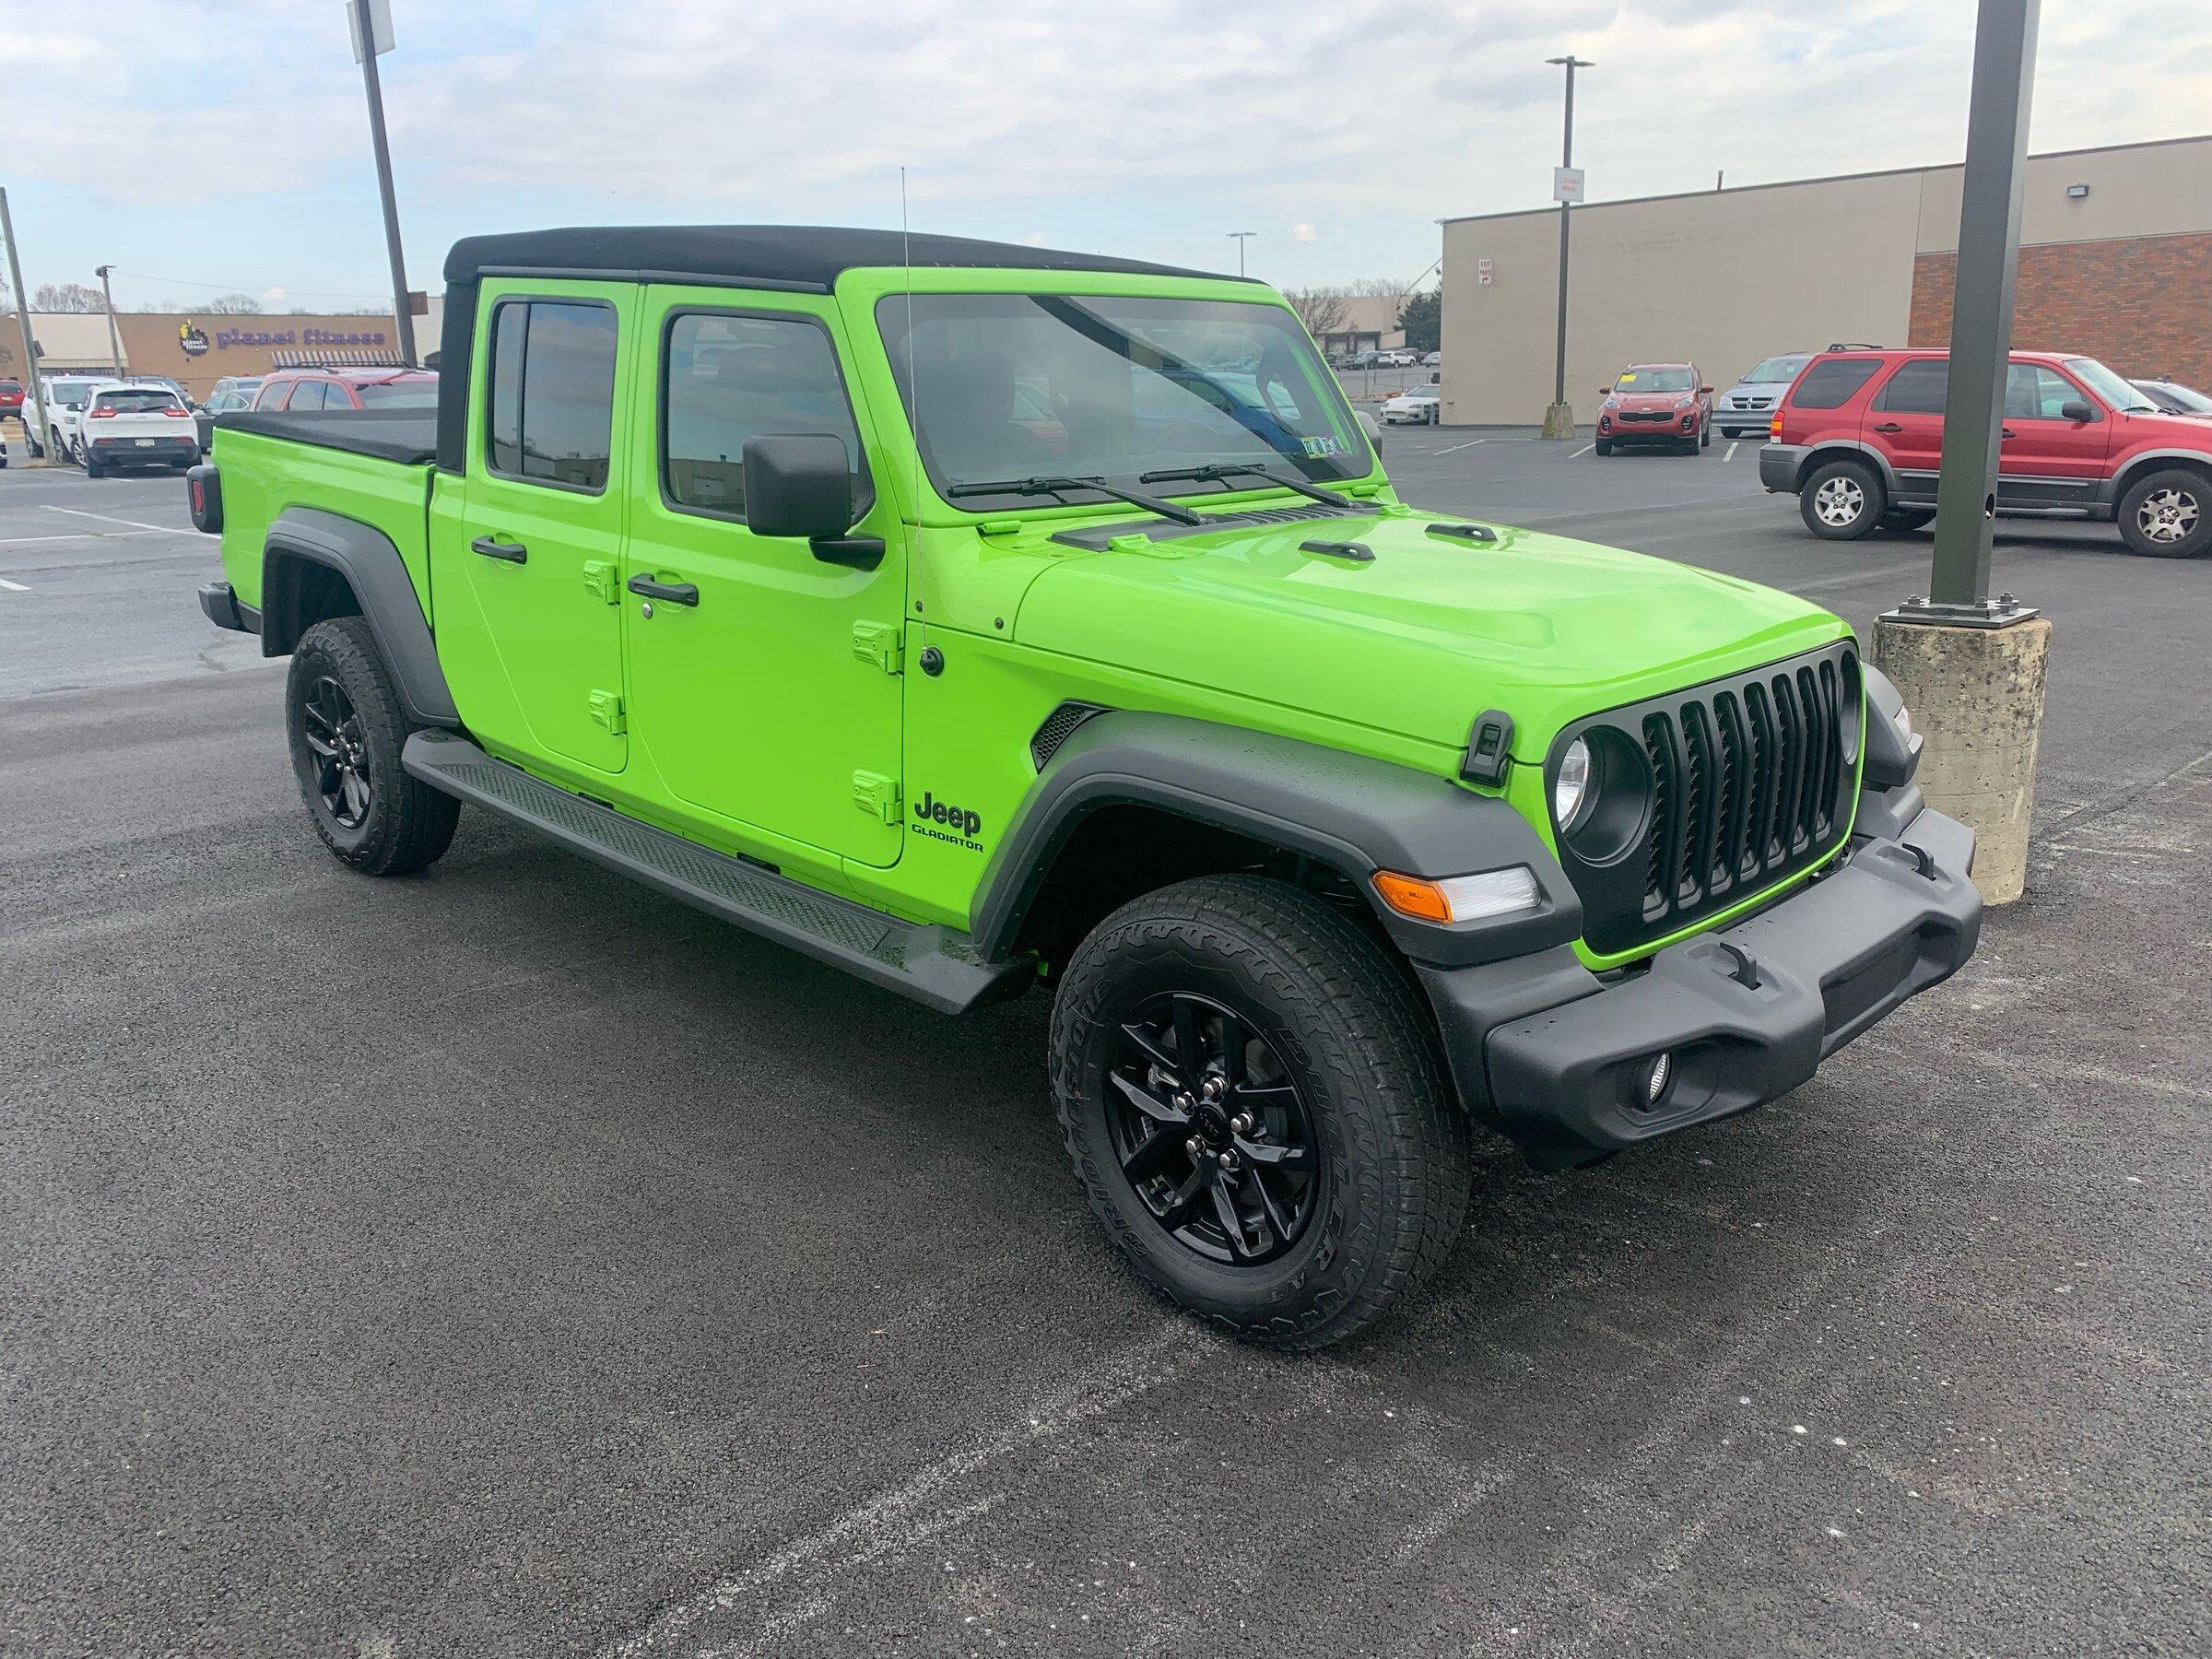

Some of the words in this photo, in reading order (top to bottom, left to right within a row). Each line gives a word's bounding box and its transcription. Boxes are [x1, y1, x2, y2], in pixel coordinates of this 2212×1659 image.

[217, 328, 297, 348] planet
[303, 328, 385, 346] fitness
[914, 791, 982, 838] Jeep
[912, 823, 983, 853] GLADIATOR
